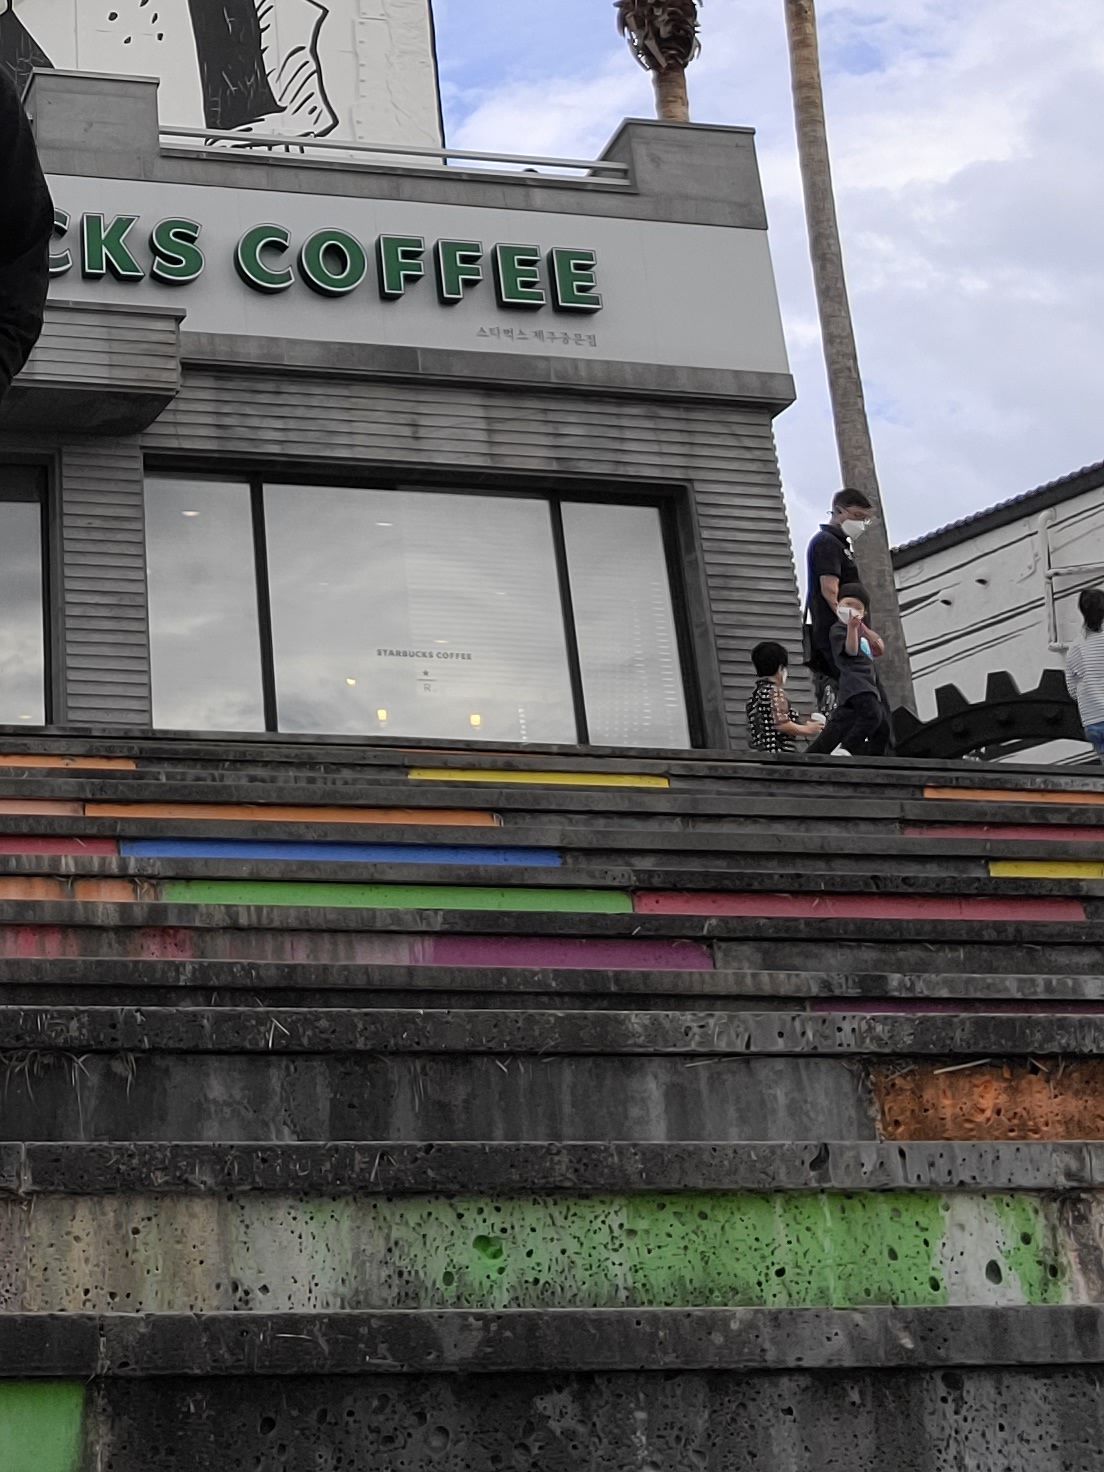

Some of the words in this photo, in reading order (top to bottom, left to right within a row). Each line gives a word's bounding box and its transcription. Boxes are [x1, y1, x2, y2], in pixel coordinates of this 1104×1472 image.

[234, 222, 603, 314] COFFEE
[376, 648, 434, 659] STARBUCKS
[436, 651, 473, 661] COFFEE
